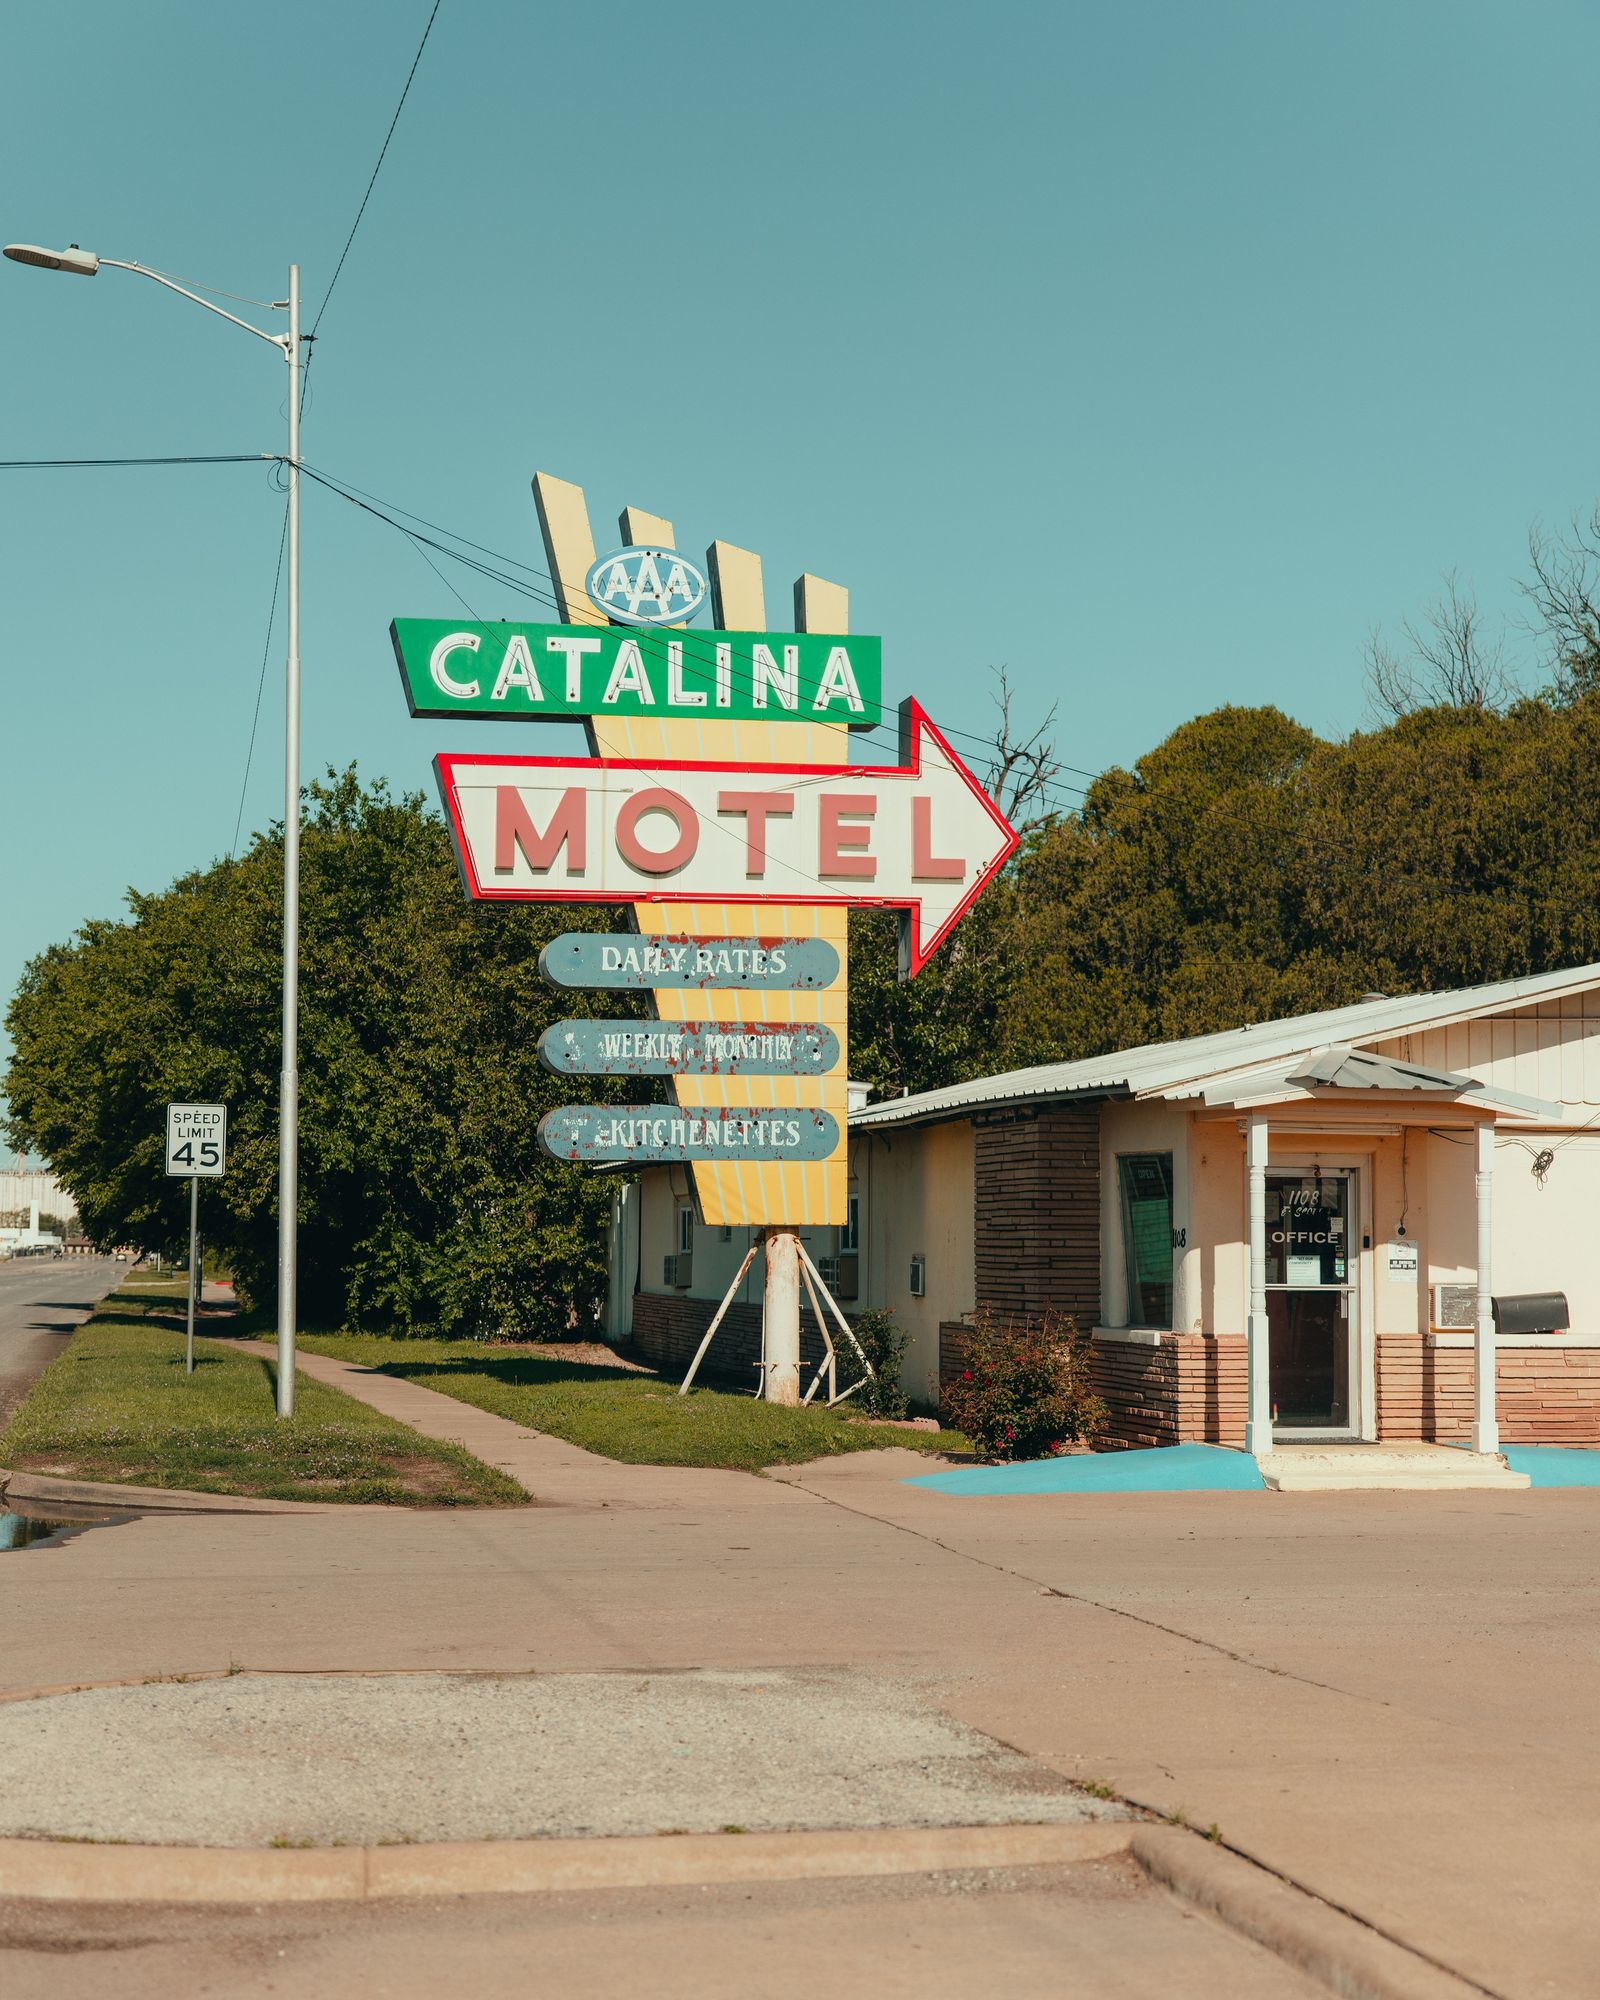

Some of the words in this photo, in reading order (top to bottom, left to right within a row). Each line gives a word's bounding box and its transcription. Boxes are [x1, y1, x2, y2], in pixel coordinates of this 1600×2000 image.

[604, 551, 694, 616] AAA
[429, 632, 866, 713] CATALINA
[495, 785, 967, 880] MOTEL
[602, 946, 688, 975] DAILY
[696, 949, 787, 975] RATES
[604, 1033, 686, 1060] WEEKLY
[704, 1033, 794, 1061] MONTHLY
[173, 1113, 221, 1124] SPEED
[178, 1128, 215, 1138] LIMIT
[610, 1119, 801, 1147] KITCHENETTES
[172, 1142, 220, 1167] 45
[1289, 1190, 1320, 1206] 1108
[1271, 1231, 1339, 1244] OFFICE
